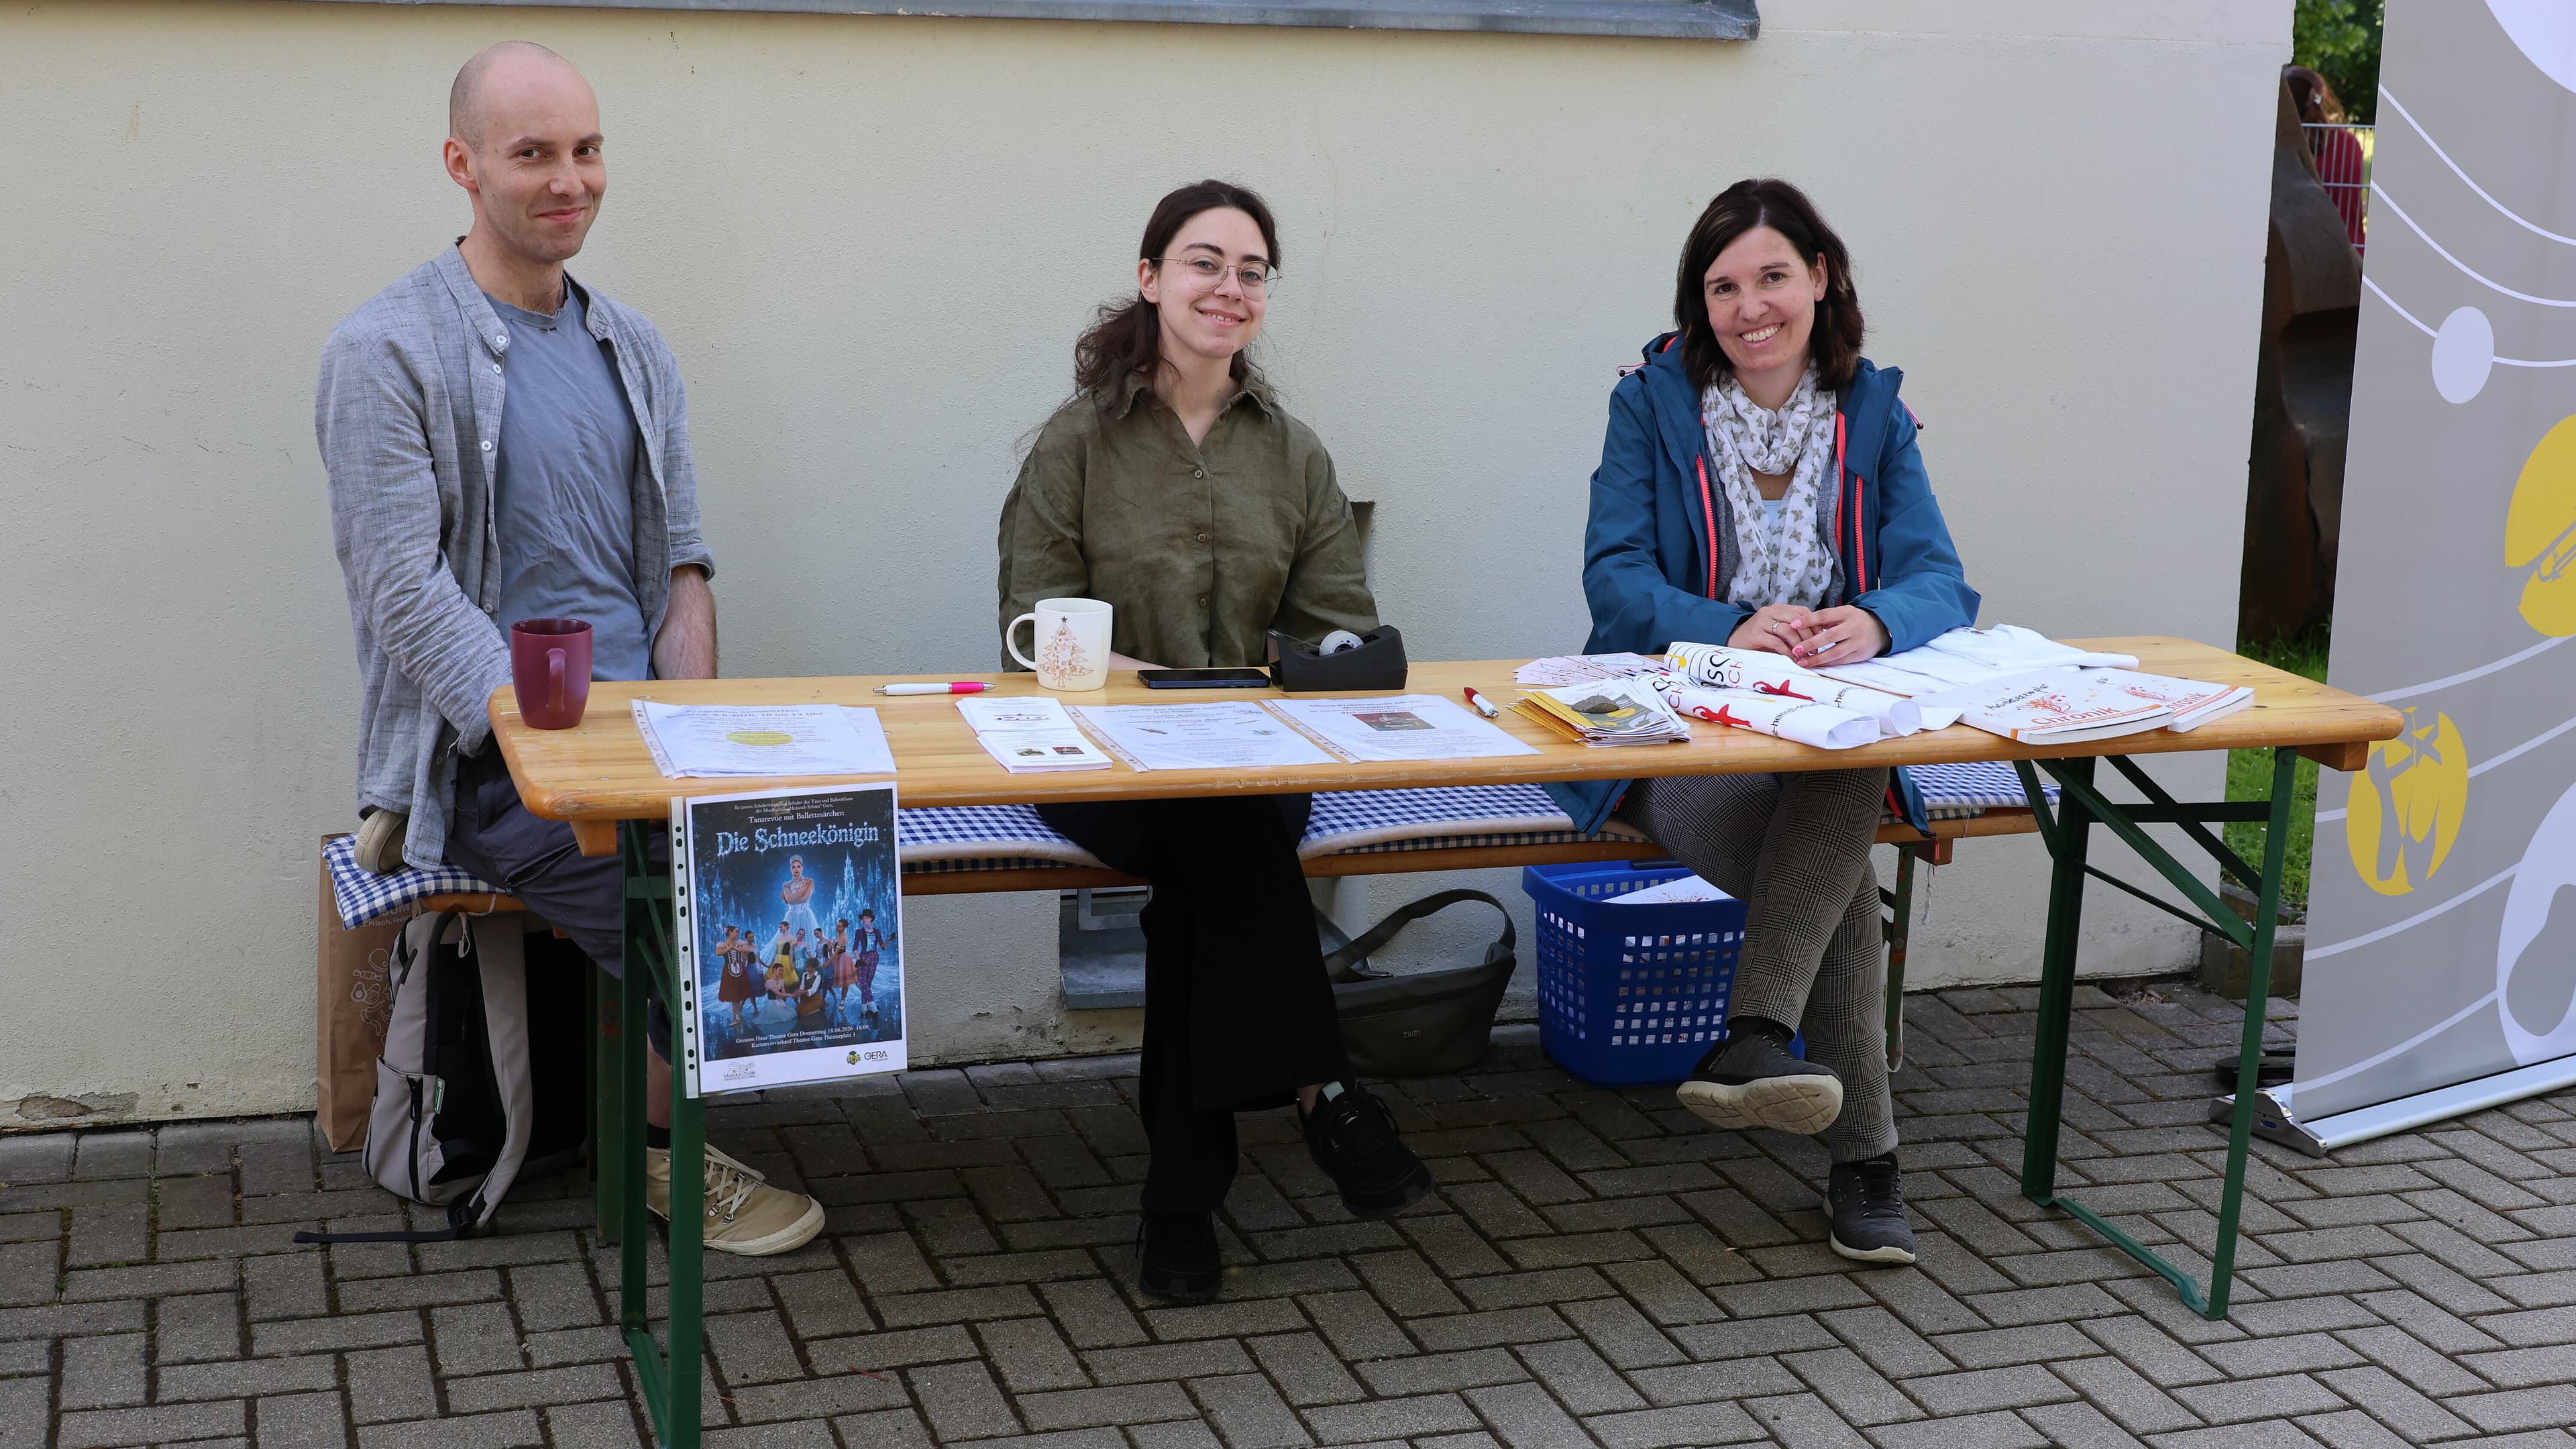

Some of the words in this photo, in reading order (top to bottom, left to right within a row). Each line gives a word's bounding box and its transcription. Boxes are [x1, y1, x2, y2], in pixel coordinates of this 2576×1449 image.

[2030, 706, 2121, 726] Chronik
[748, 815, 783, 824] Tanzrevue
[796, 810, 845, 820] Ballettmärchen
[716, 830, 749, 857] Die
[755, 821, 879, 853] Schneekönigin
[368, 919, 392, 927] Frisch.
[800, 1029, 826, 1037] Donnerstag
[751, 1038, 793, 1049] Kartenvorverkauf
[793, 1036, 811, 1044] Theater
[824, 1032, 852, 1041] Theaterplatz
[864, 1050, 888, 1061] GERA
